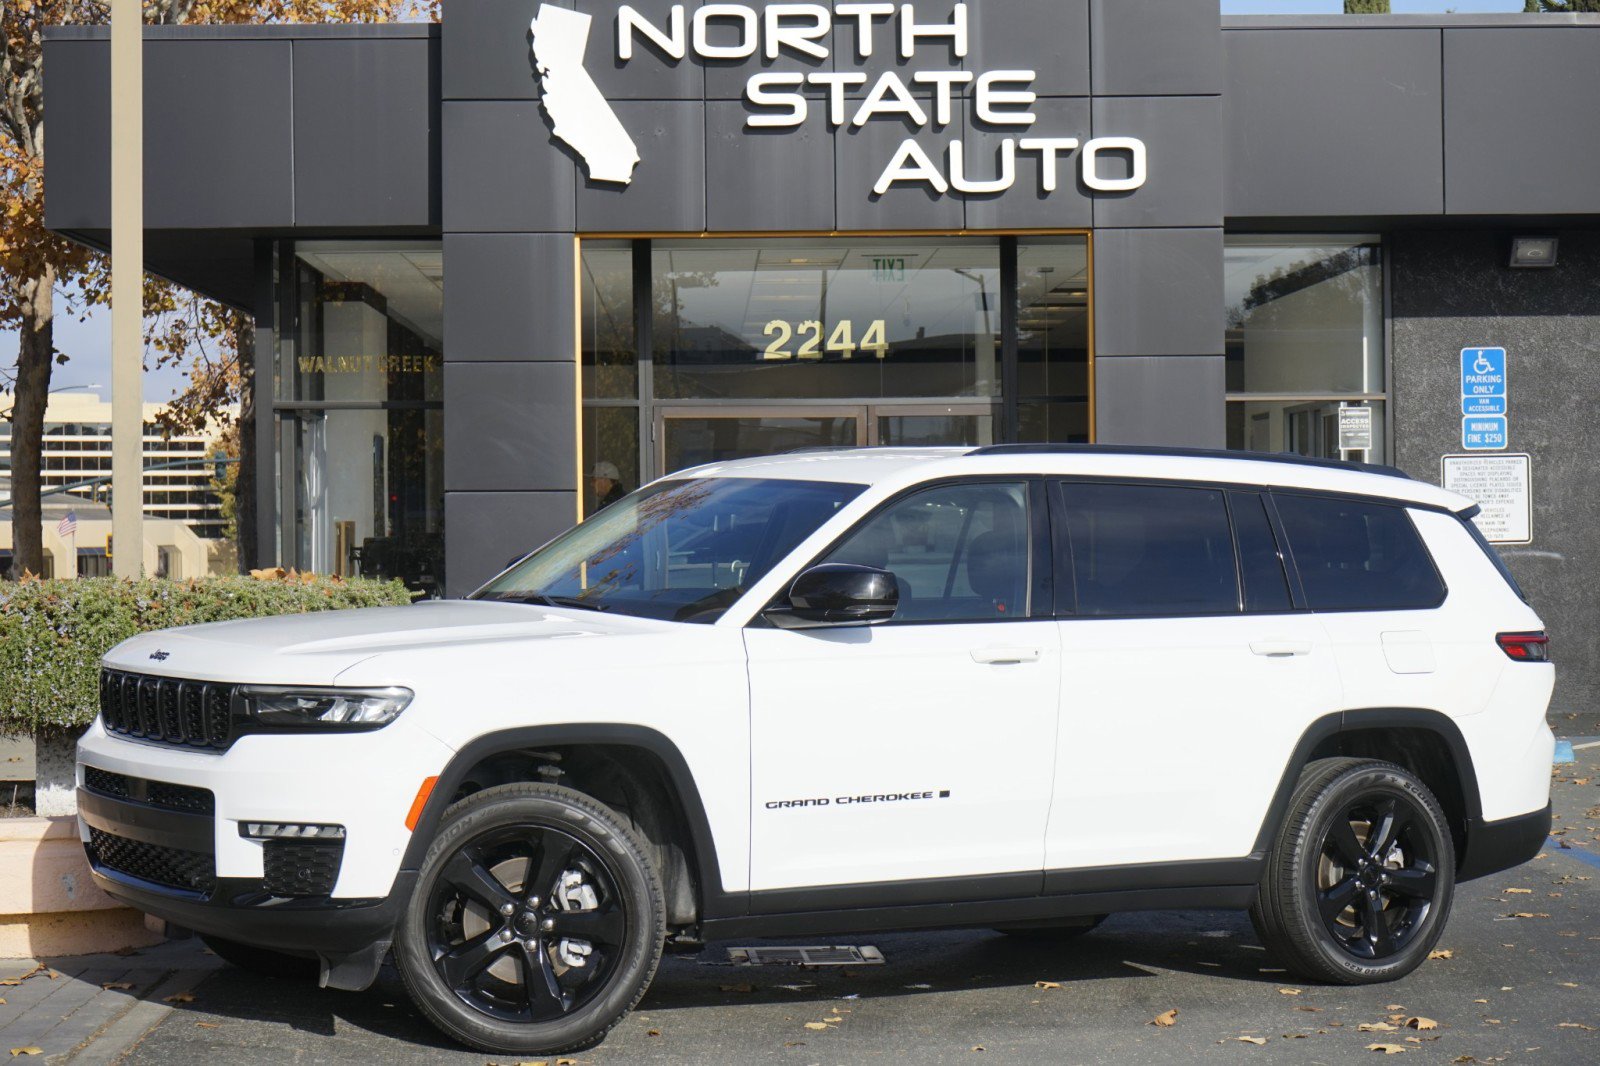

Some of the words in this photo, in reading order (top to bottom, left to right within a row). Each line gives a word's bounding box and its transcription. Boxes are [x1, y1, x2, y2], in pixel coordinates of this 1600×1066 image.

[618, 3, 967, 60] NORTH
[746, 70, 1036, 127] STATE
[873, 137, 1147, 194] AUTO
[763, 319, 889, 359] 2244
[298, 356, 373, 373] WALNUT
[378, 355, 433, 373] CREEK
[1465, 374, 1502, 384] PARKING
[1472, 385, 1495, 394] ONLY
[1471, 422, 1498, 432] MINIMUM
[1467, 433, 1482, 443] FINE
[1484, 433, 1503, 443] $250
[765, 799, 830, 810] GRAND
[835, 791, 934, 805] CHEROKEE
